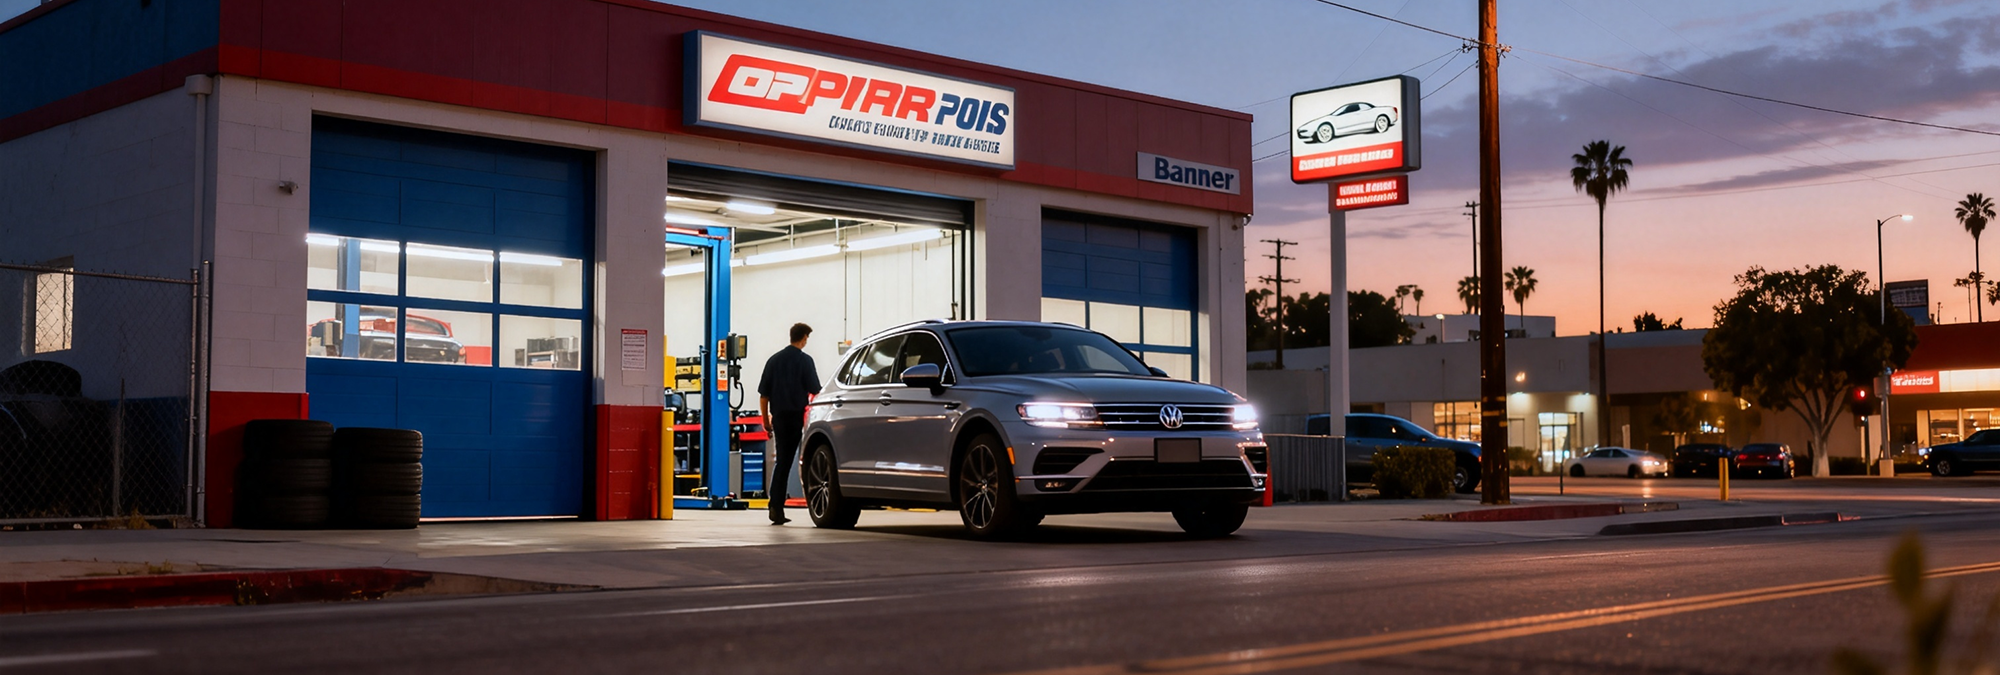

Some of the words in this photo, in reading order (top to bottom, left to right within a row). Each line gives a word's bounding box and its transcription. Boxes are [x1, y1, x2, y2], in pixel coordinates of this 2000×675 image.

[935, 93, 1009, 135] POIS
[1155, 157, 1234, 190] Banner
[1161, 404, 1183, 428] VW
